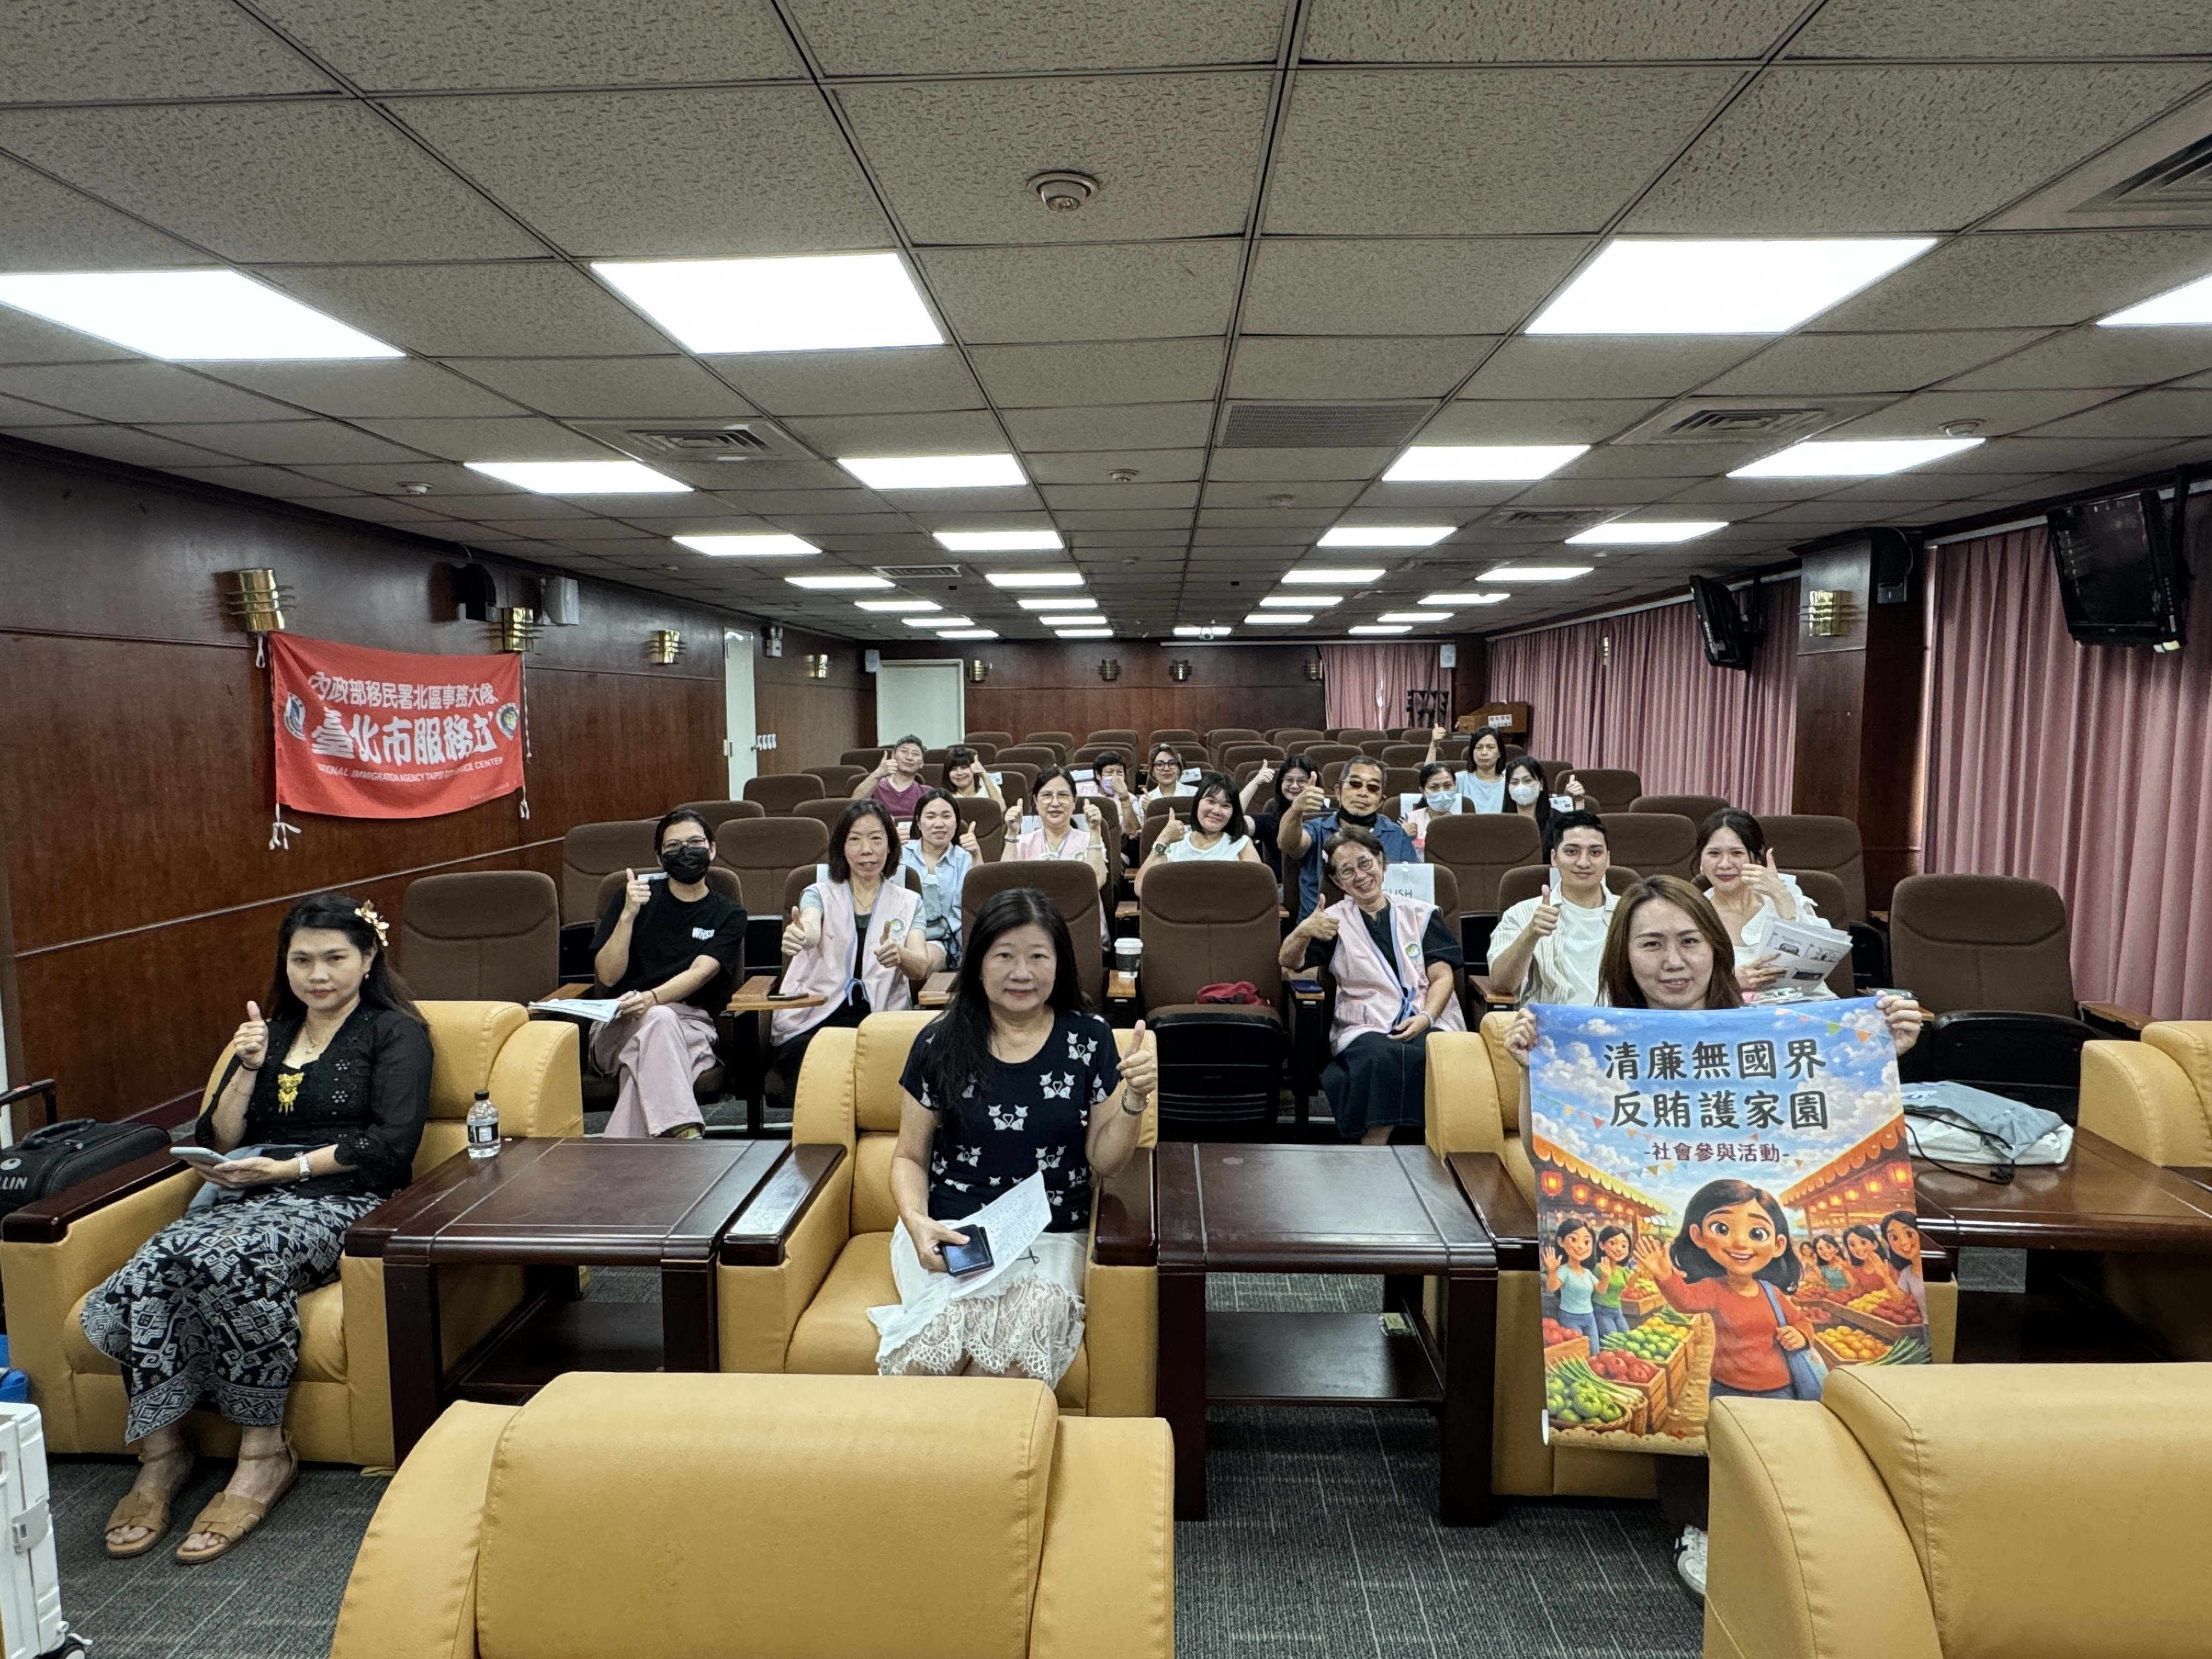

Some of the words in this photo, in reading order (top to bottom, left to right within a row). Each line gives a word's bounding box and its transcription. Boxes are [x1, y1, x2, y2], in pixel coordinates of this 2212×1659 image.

[474, 756, 504, 770] CENTER
[1604, 1039, 1827, 1080] 清廉無國界
[1610, 1090, 1829, 1131] 反賄護家園
